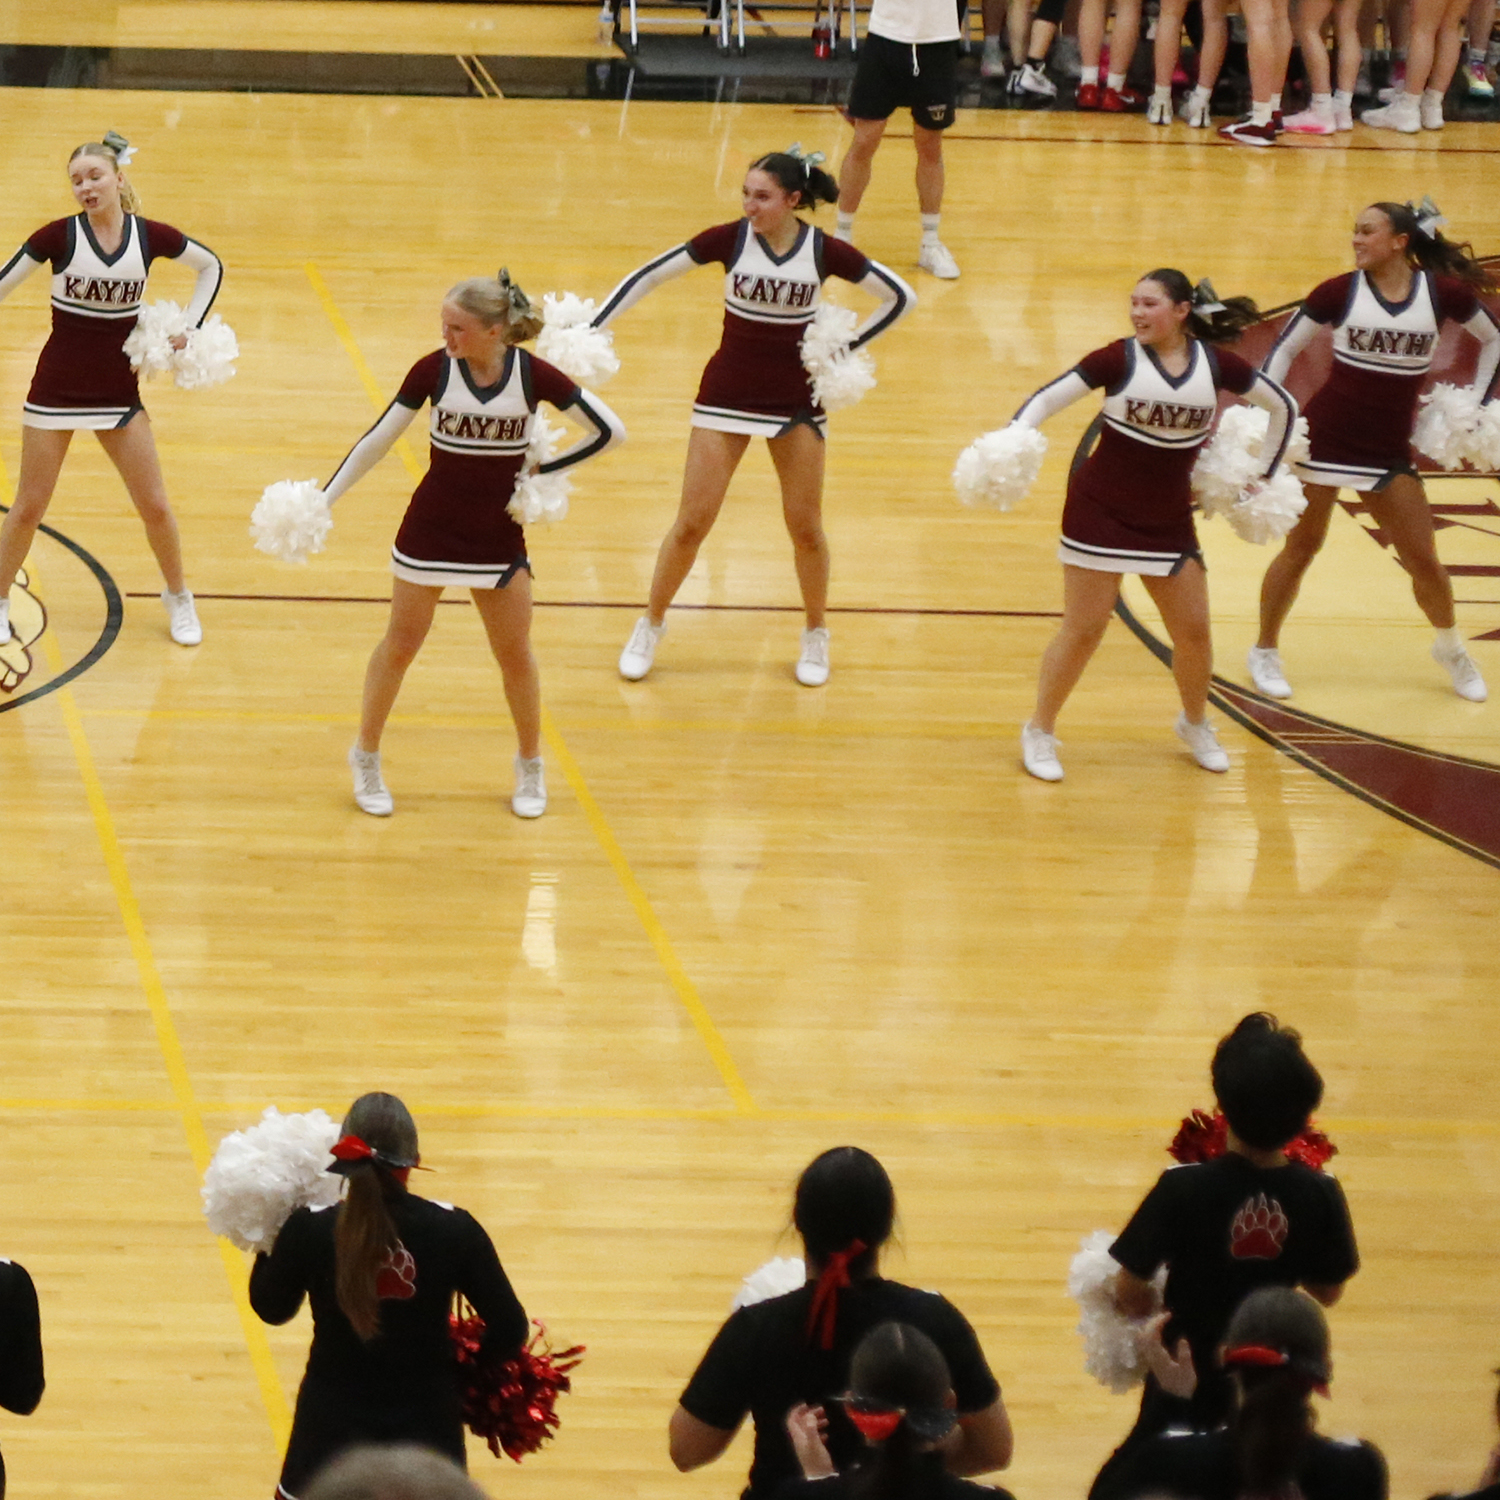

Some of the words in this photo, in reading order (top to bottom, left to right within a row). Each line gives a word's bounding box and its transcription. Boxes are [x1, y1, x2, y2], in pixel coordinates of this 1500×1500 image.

[733, 274, 817, 307] KAYHI
[1346, 327, 1436, 356] KAYHI
[437, 410, 526, 440] KAYHI
